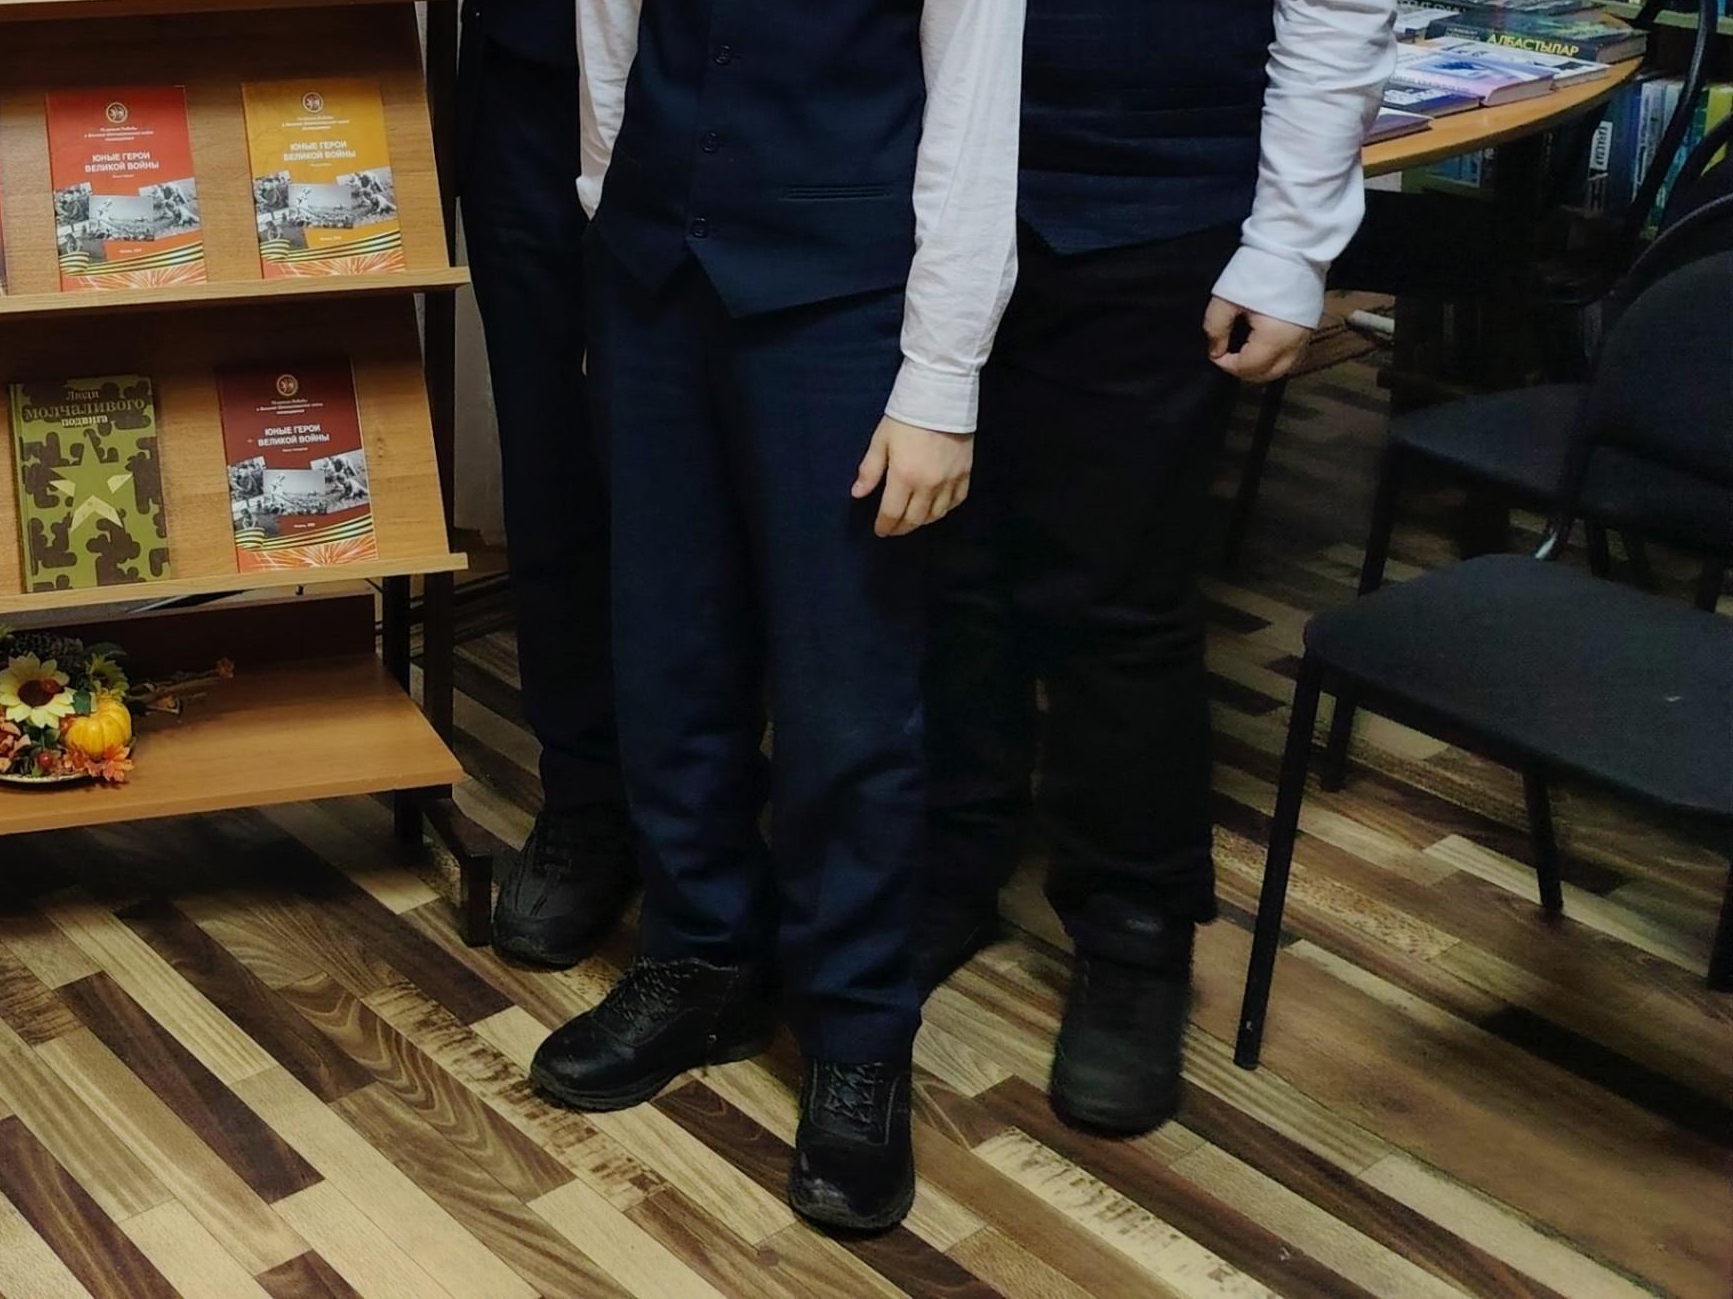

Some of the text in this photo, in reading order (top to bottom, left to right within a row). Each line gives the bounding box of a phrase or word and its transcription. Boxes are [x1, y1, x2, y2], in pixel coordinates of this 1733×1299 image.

[1487, 33, 1580, 57] АЛБАСТЫЛАР
[290, 140, 347, 151] ЮНЫЕ ГЕРОИ
[92, 151, 151, 162] ЮНЫЕ ГЕРОИ
[283, 149, 356, 162] ВЕЛИКОЙ ВОЙНЫ
[84, 159, 160, 173] ВЕЛИКОЙ ВОЙНЫ
[66, 390, 100, 401] Люди
[24, 398, 146, 420] молчаливого
[61, 414, 108, 428] подвига
[264, 424, 321, 437] ЮНЫЕ ГЕРОИ
[258, 433, 330, 447] ВЕЛИКОЙ ВОЙНЫ
